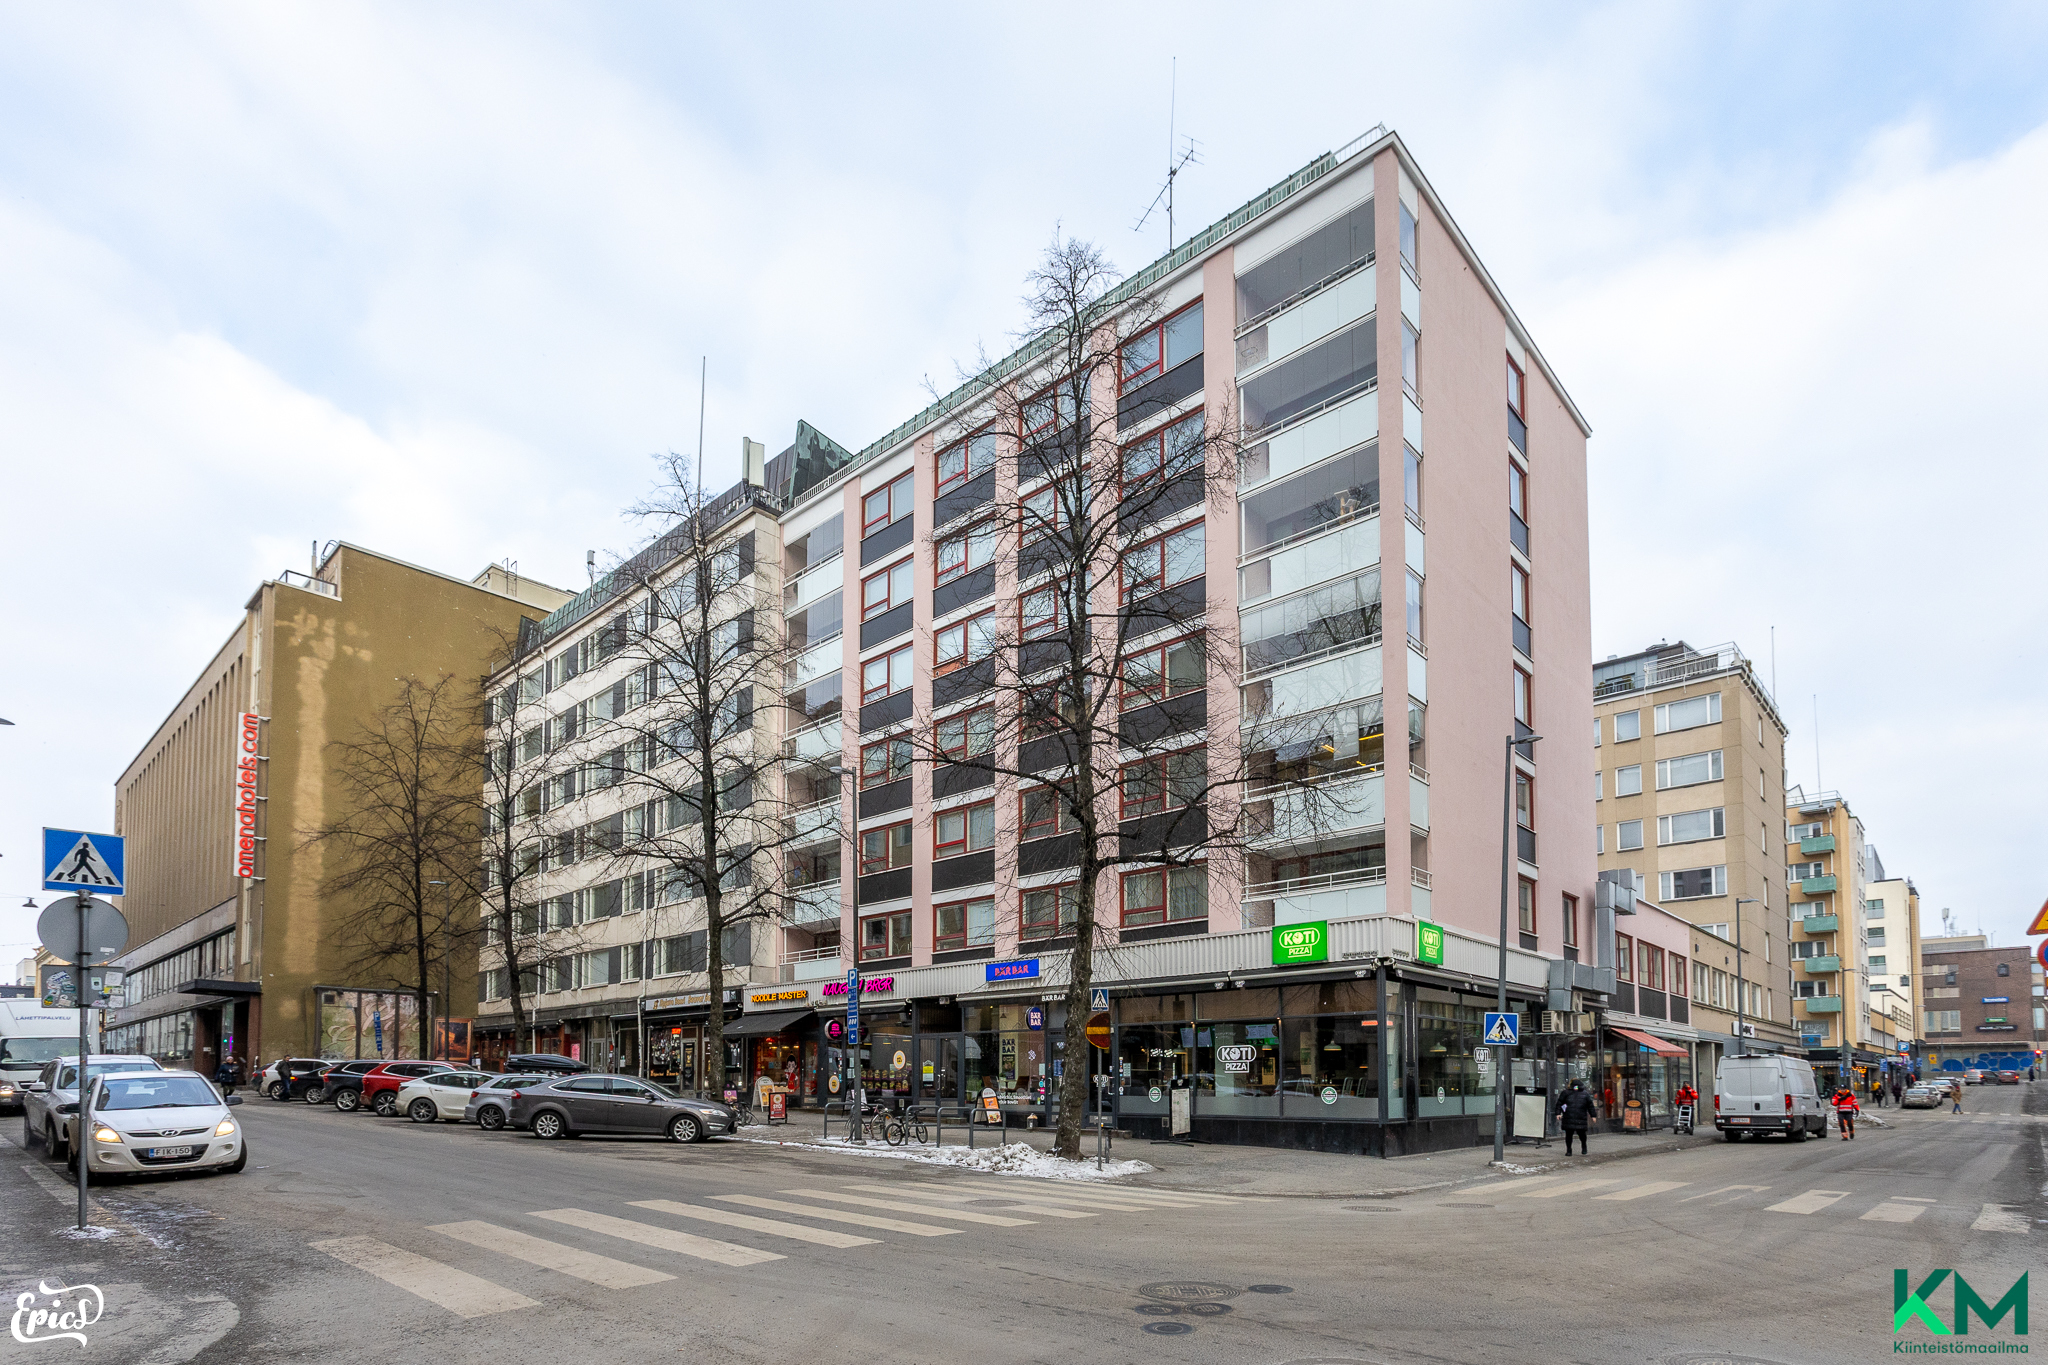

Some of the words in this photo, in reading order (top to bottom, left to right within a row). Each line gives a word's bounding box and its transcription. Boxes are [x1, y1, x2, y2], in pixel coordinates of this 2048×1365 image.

[236, 712, 258, 878] omenahotels.com
[1284, 930, 1315, 946] KOTI
[1424, 930, 1439, 946] KOTI
[1288, 946, 1310, 956] PIZZA
[1425, 946, 1436, 955] PIZZA
[1011, 964, 1029, 975] BAR
[849, 970, 856, 987] P
[822, 979, 864, 996] NAUG
[865, 977, 893, 993] BRGR
[750, 992, 777, 1003] NOODLE
[778, 989, 807, 1000] MASTER
[1053, 993, 1066, 1001] BAR
[1002, 1046, 1016, 1054] BAR
[1221, 1047, 1252, 1061] KOTI
[1476, 1049, 1489, 1062] KOTI
[1225, 1062, 1247, 1071] PIZZA
[155, 1147, 190, 1156] FIK-150
